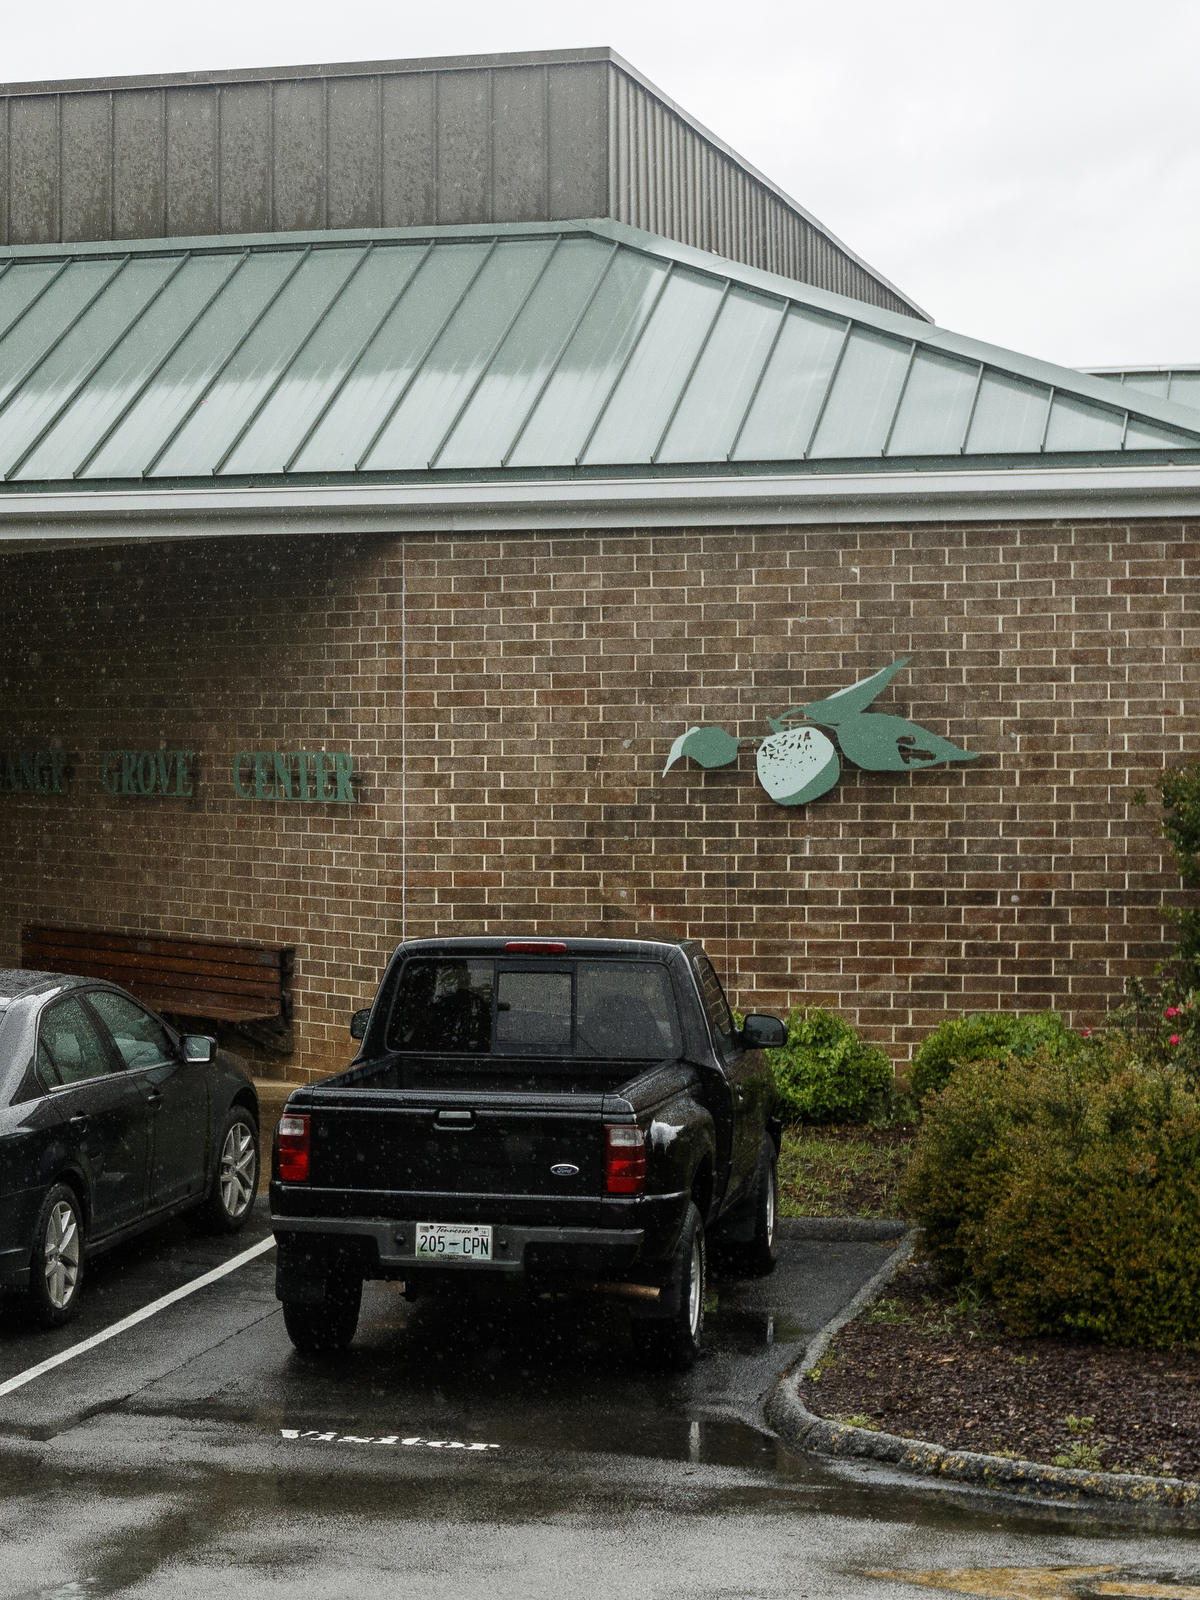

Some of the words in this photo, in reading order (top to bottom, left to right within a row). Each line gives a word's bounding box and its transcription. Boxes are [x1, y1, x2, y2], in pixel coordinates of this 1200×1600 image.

[103, 749, 195, 797] GROVE
[233, 751, 357, 802] CENTER
[436, 1226, 472, 1234] Tennessee
[420, 1235, 489, 1255] 205-CPN
[280, 1429, 500, 1450] Visitor
